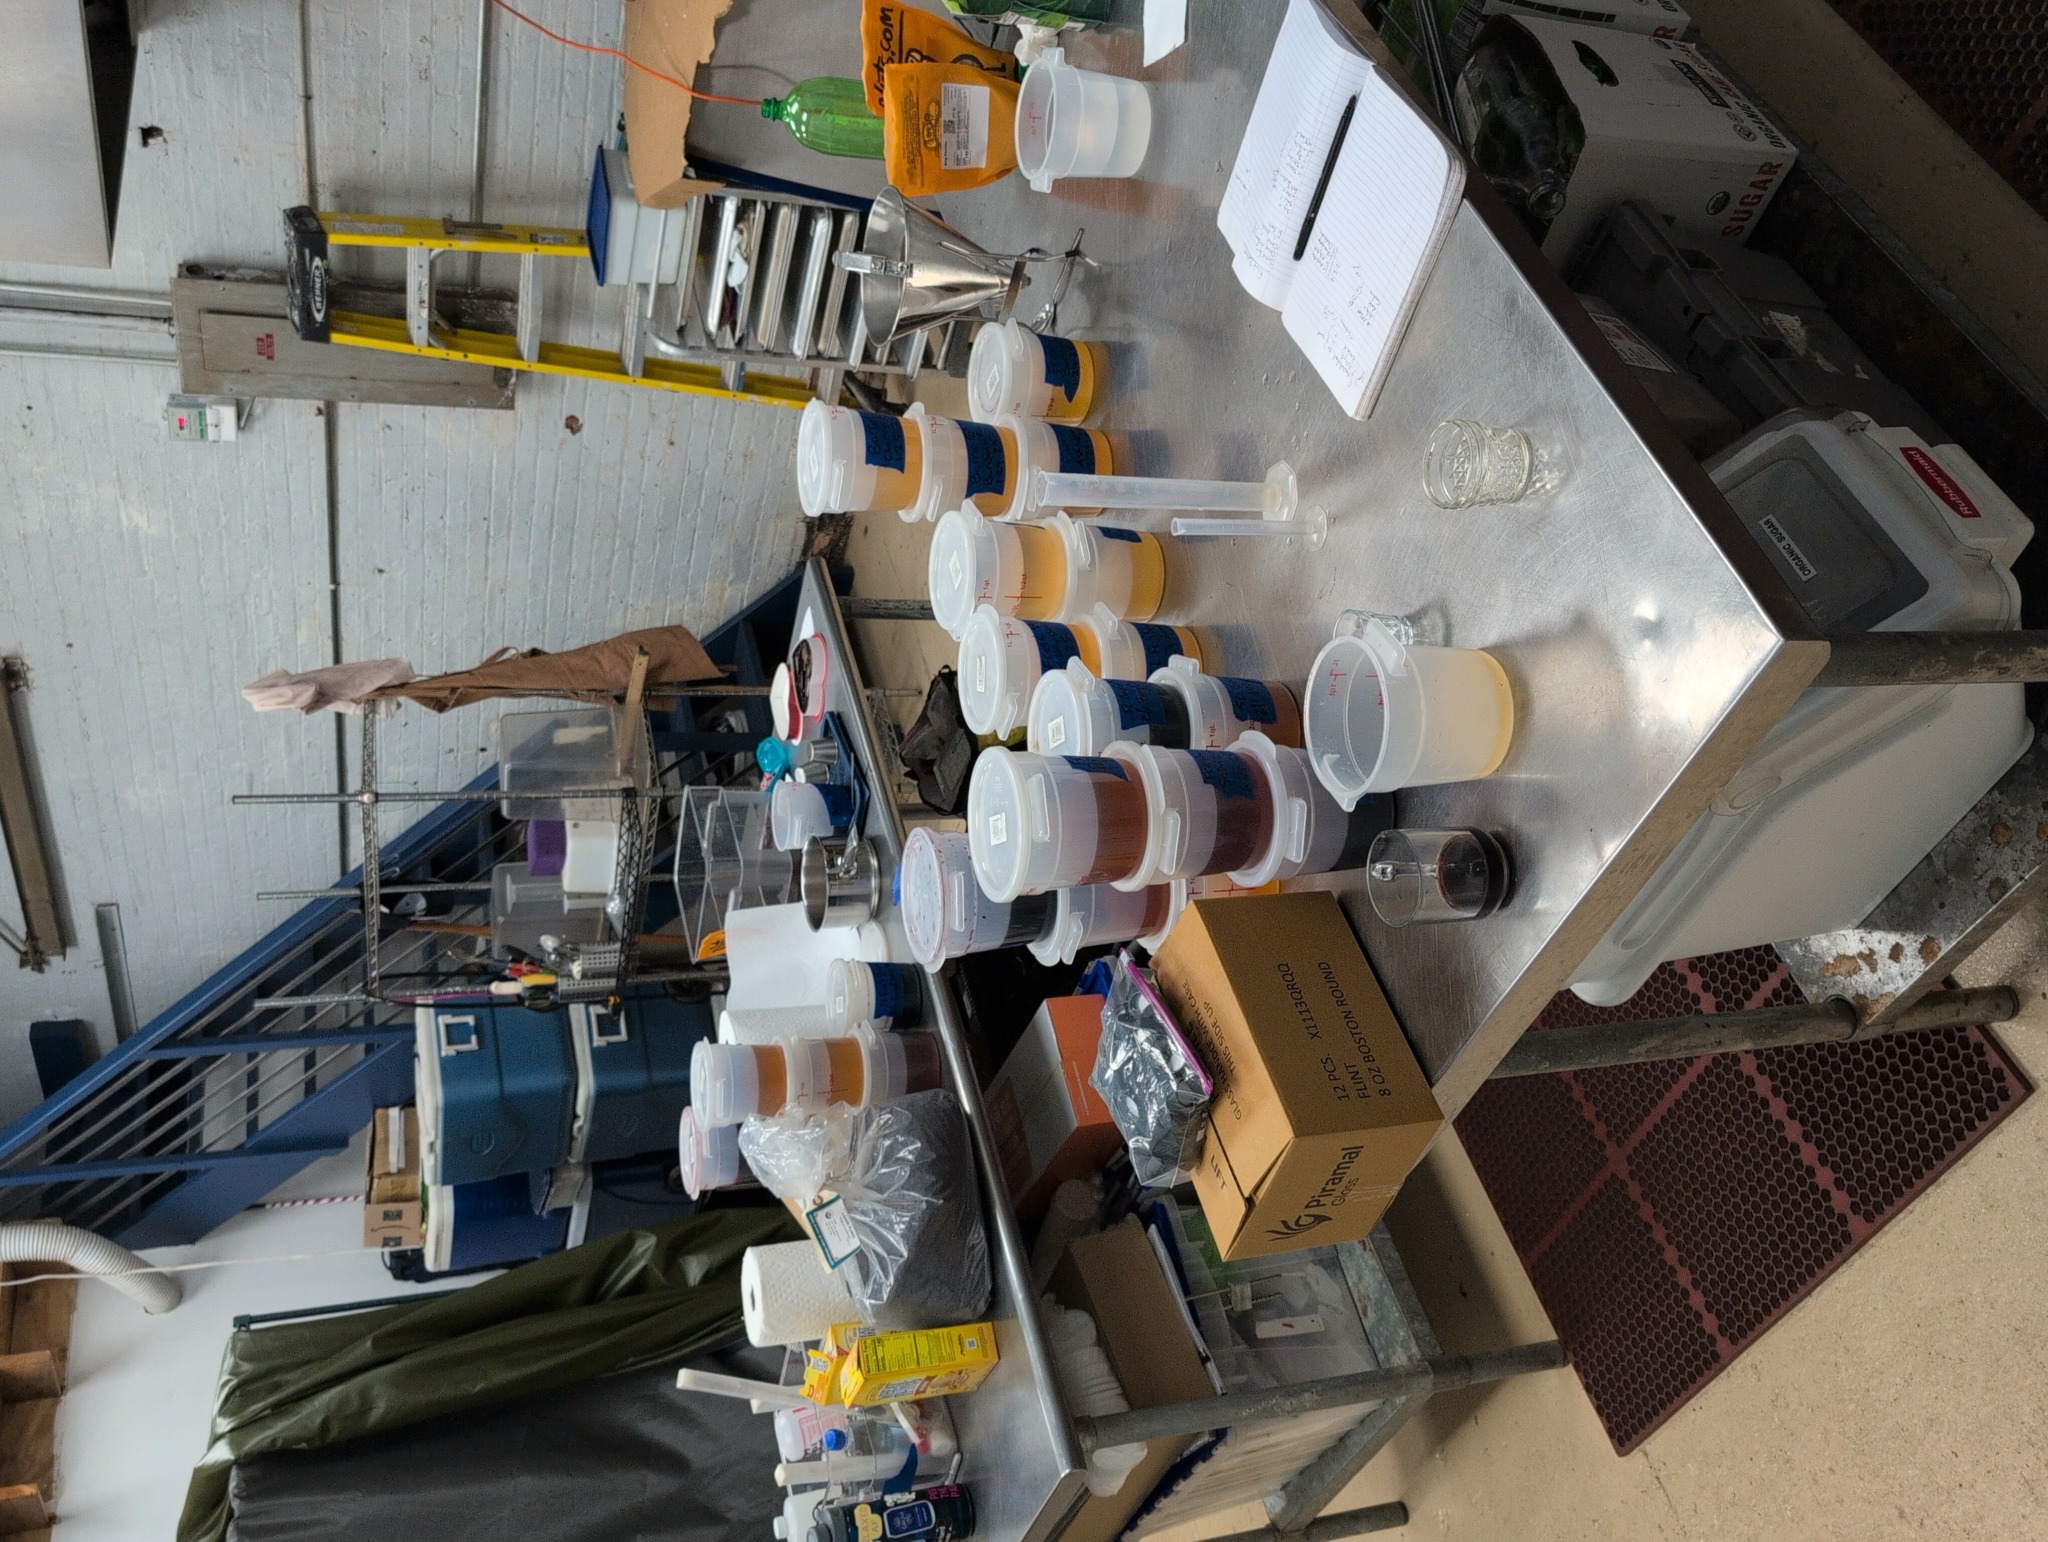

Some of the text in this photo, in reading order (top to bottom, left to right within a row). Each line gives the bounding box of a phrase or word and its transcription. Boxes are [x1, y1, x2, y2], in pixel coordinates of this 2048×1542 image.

[1734, 101, 1787, 149] ORGANIC
[1721, 161, 1783, 237] SUGAR
[313, 269, 323, 310] WERNER
[1908, 450, 1973, 515] Rubbermaid
[1763, 517, 1812, 578] ORGANIC SUGAR
[1181, 978, 1197, 1008] CARE
[1203, 1000, 1215, 1016] UP
[1194, 1008, 1211, 1038] WITH
[1211, 1018, 1226, 1046] SIDE
[1277, 962, 1350, 1102] 12 PCS. X1113QRQQ
[1318, 961, 1392, 1097] 8 OZ BOSTON ROUND
[1206, 1037, 1228, 1084] HANDLE
[1222, 1046, 1237, 1076] THIS
[1344, 1062, 1372, 1099] FLINT
[1222, 1084, 1242, 1120] GLASS
[1210, 1154, 1227, 1190] LIFT
[1303, 1144, 1364, 1210] Piramal
[1330, 1176, 1360, 1207] Glass
